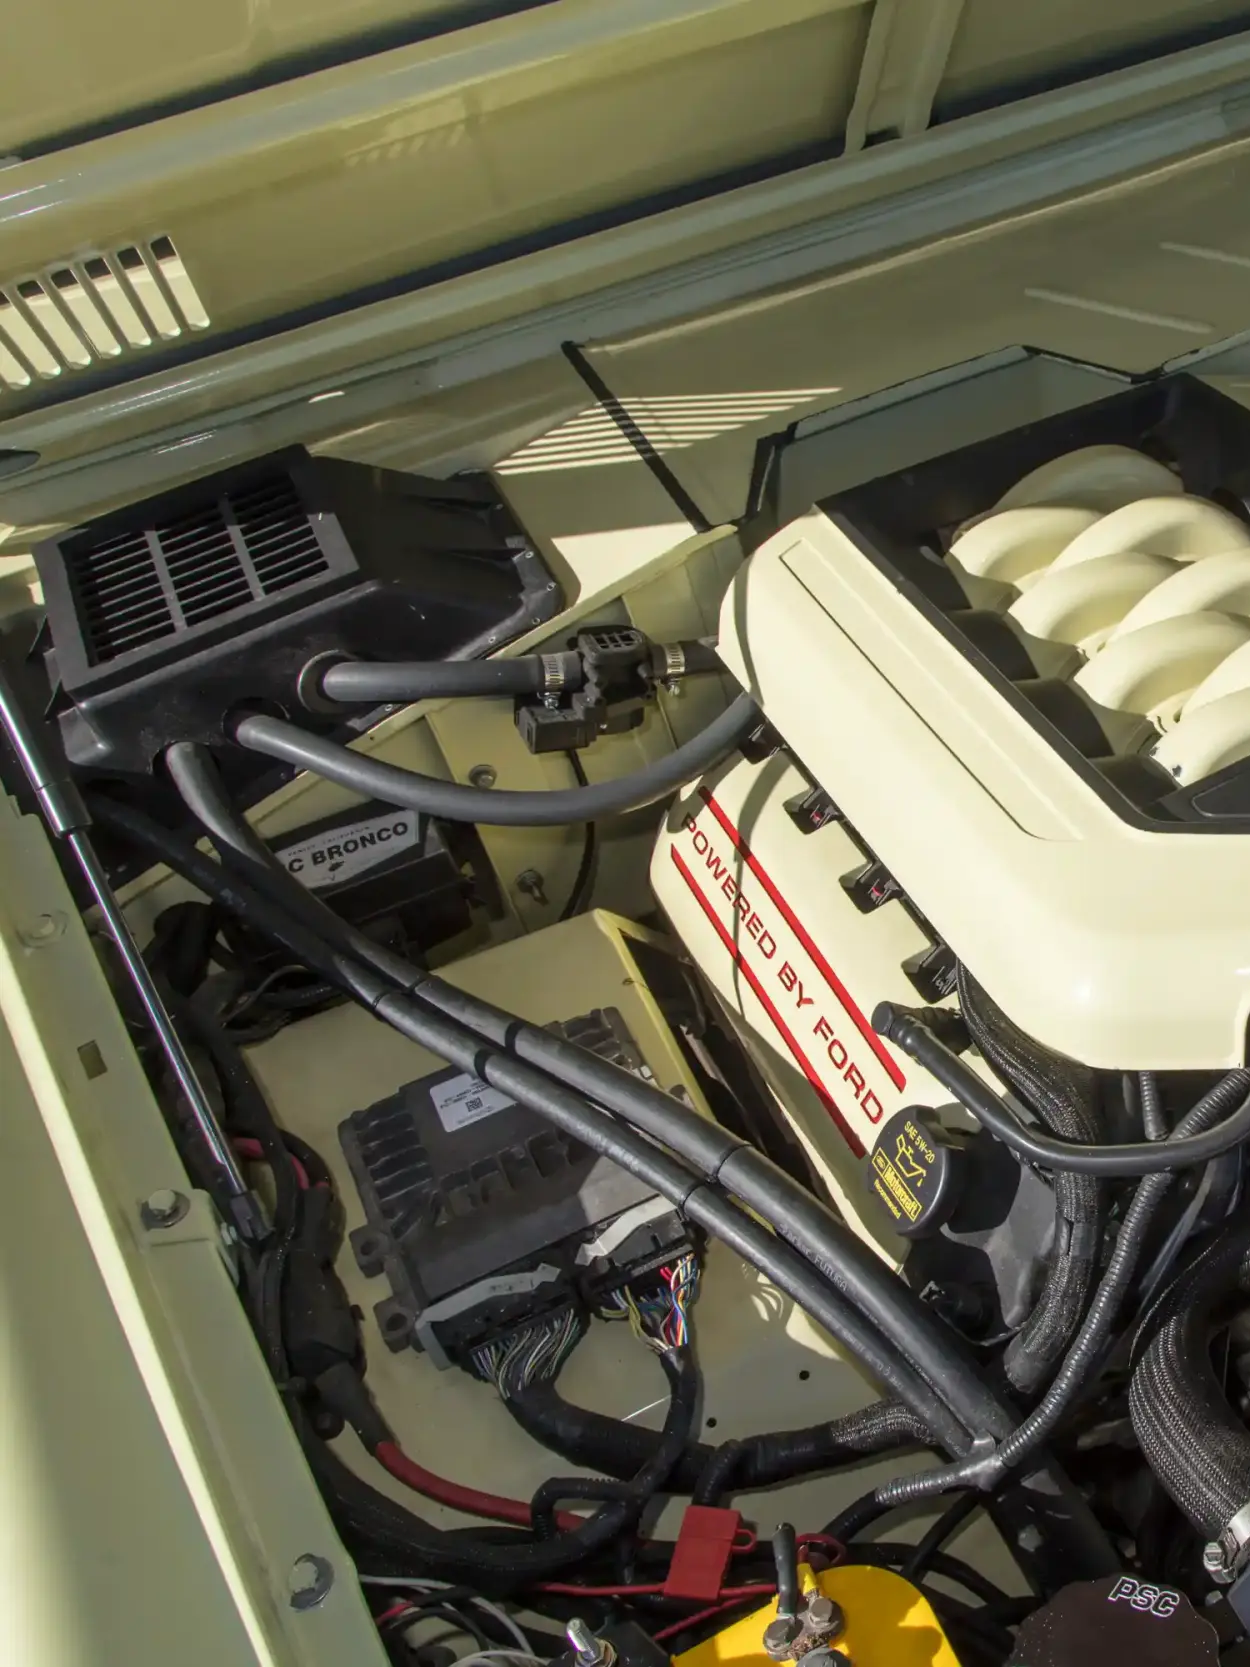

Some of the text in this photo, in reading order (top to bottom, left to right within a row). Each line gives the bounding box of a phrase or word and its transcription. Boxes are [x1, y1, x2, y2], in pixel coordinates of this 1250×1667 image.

[311, 821, 409, 867] BRONCO
[683, 812, 884, 1125] POWERED BY FORD
[904, 1120, 935, 1164] SAE 5W-20
[883, 1165, 919, 1218] Motorcraft
[814, 1254, 848, 1292] FUTURA
[1107, 1576, 1180, 1618] PSC
